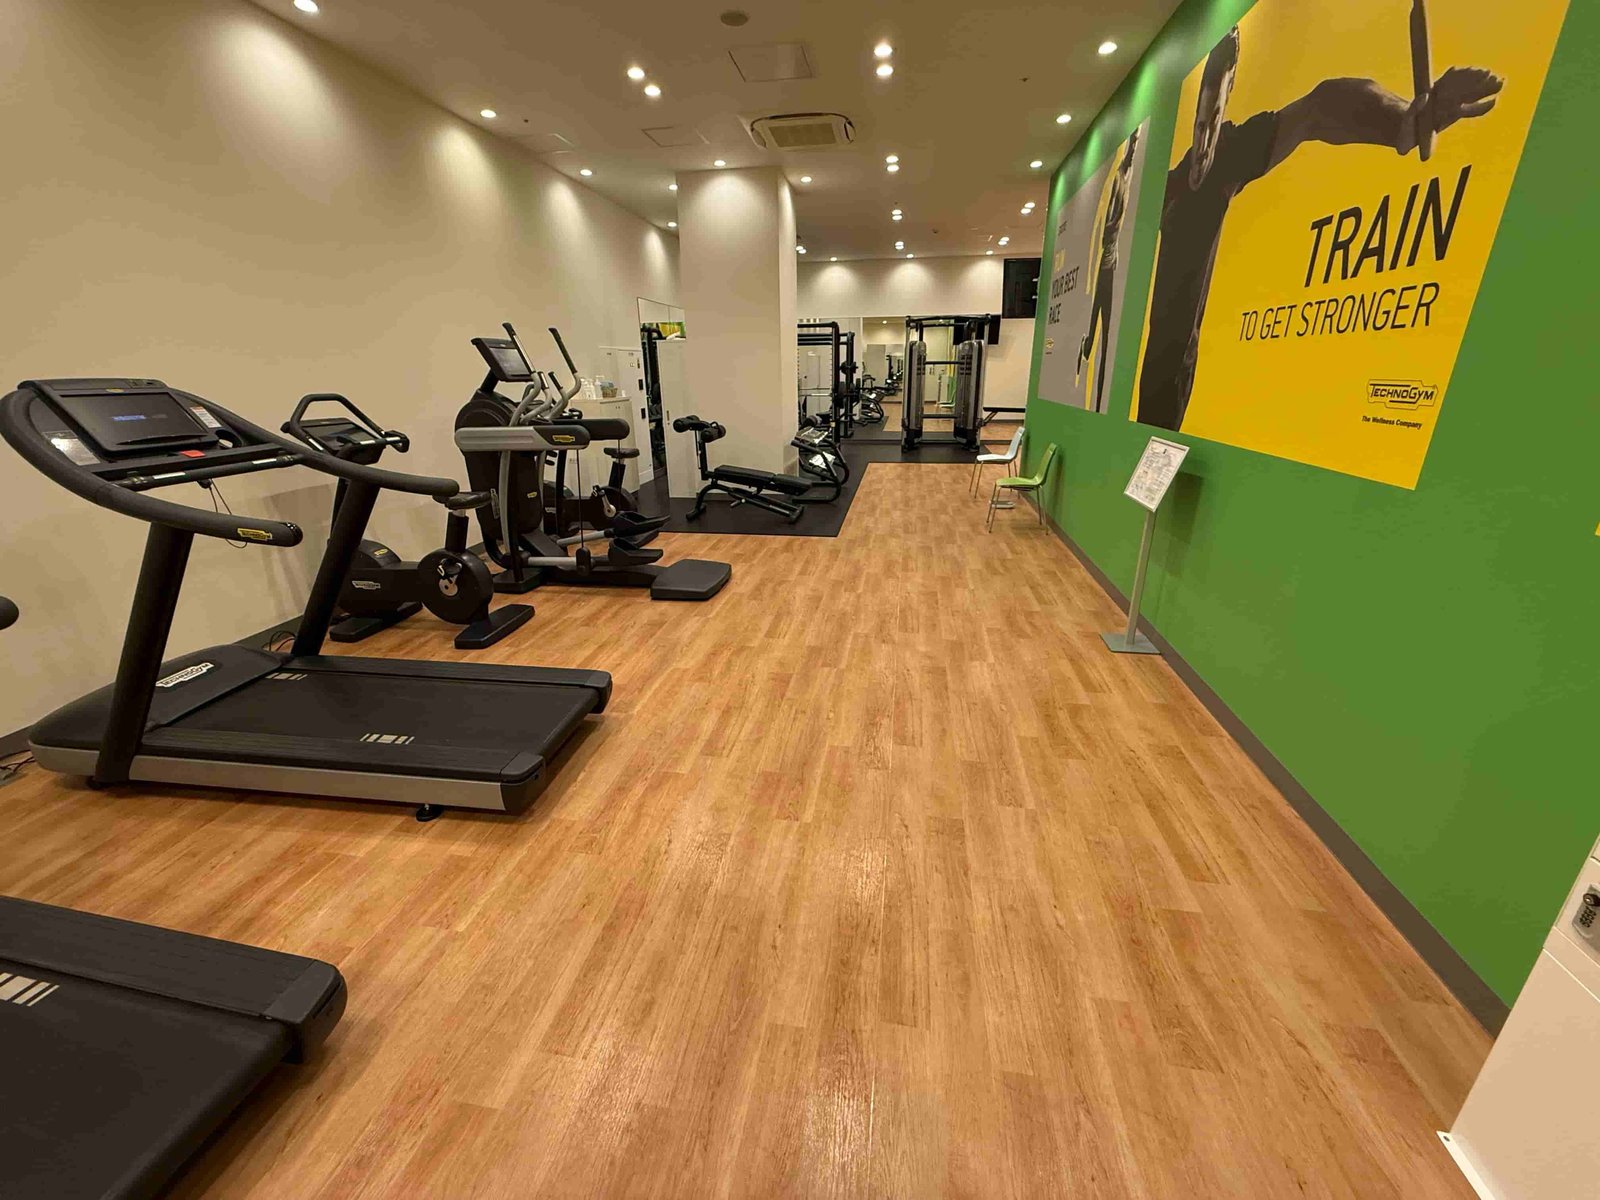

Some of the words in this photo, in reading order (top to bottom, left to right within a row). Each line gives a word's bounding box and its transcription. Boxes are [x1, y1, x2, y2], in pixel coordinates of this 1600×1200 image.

[1304, 164, 1472, 288] TRAIN
[1064, 266, 1080, 294] BEST
[1239, 310, 1258, 342] TO
[1259, 305, 1297, 340] GET
[1296, 282, 1440, 338] STRONGER
[1369, 383, 1434, 404] TECHNOGYM
[1361, 415, 1371, 423] The
[1371, 417, 1395, 426] Wellness
[1395, 420, 1422, 430] Company
